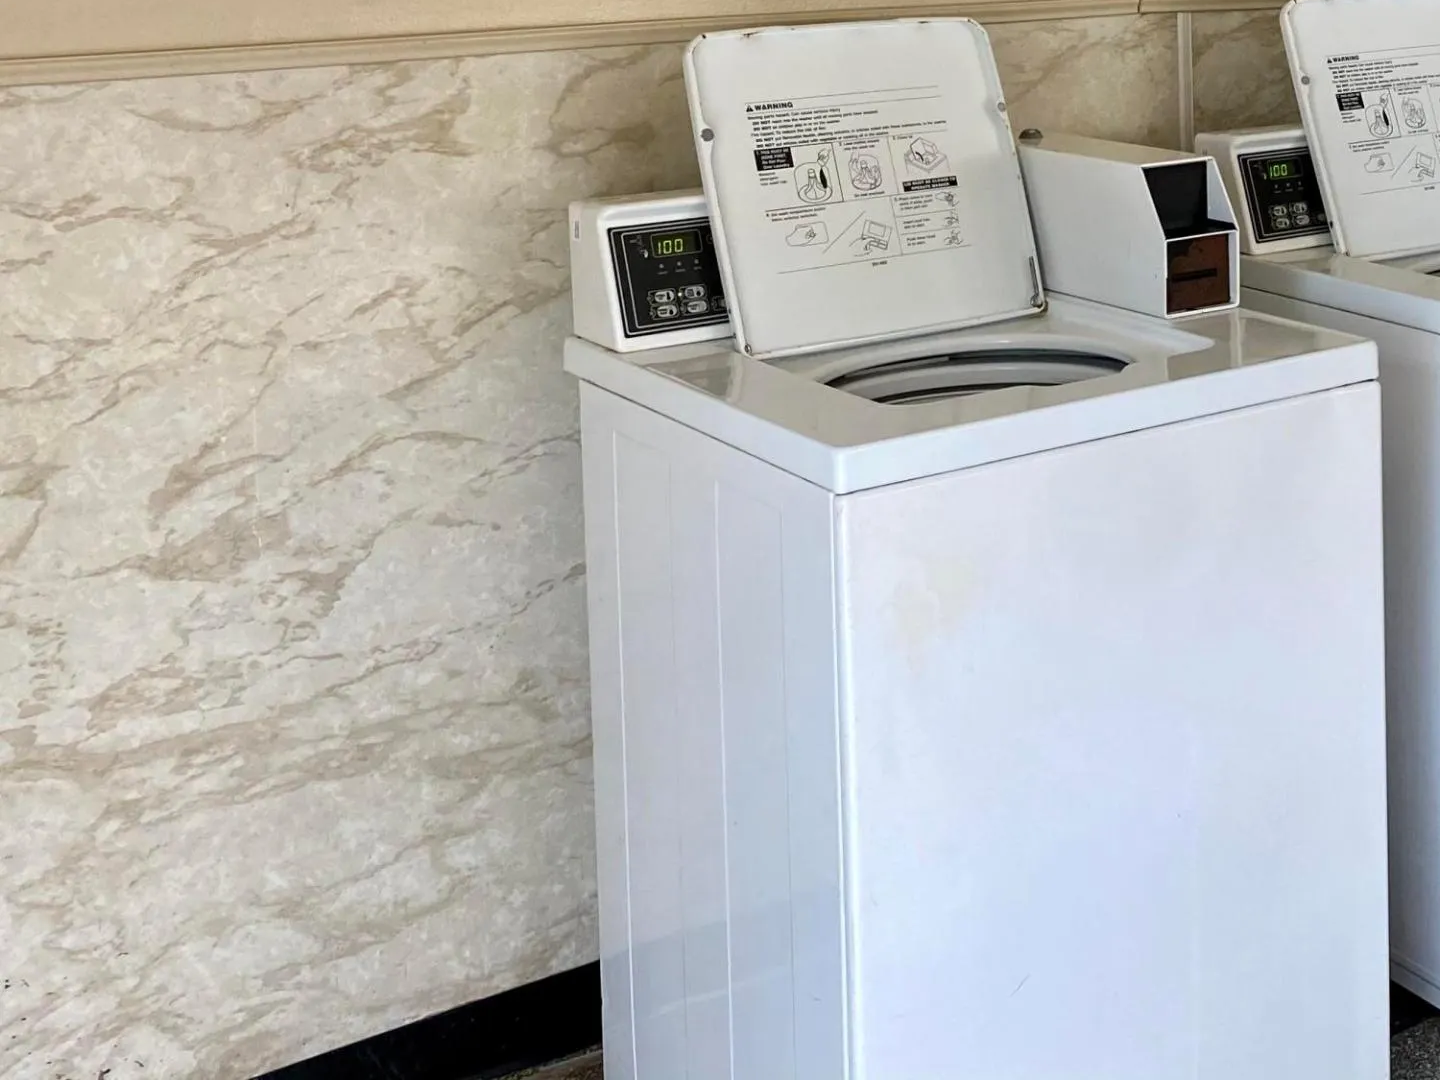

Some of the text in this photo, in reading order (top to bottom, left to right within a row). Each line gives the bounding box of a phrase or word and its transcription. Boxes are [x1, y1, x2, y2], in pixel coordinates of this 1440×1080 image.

[754, 101, 794, 111] WARNING
[1270, 163, 1288, 177] 100
[658, 239, 683, 255] 100
